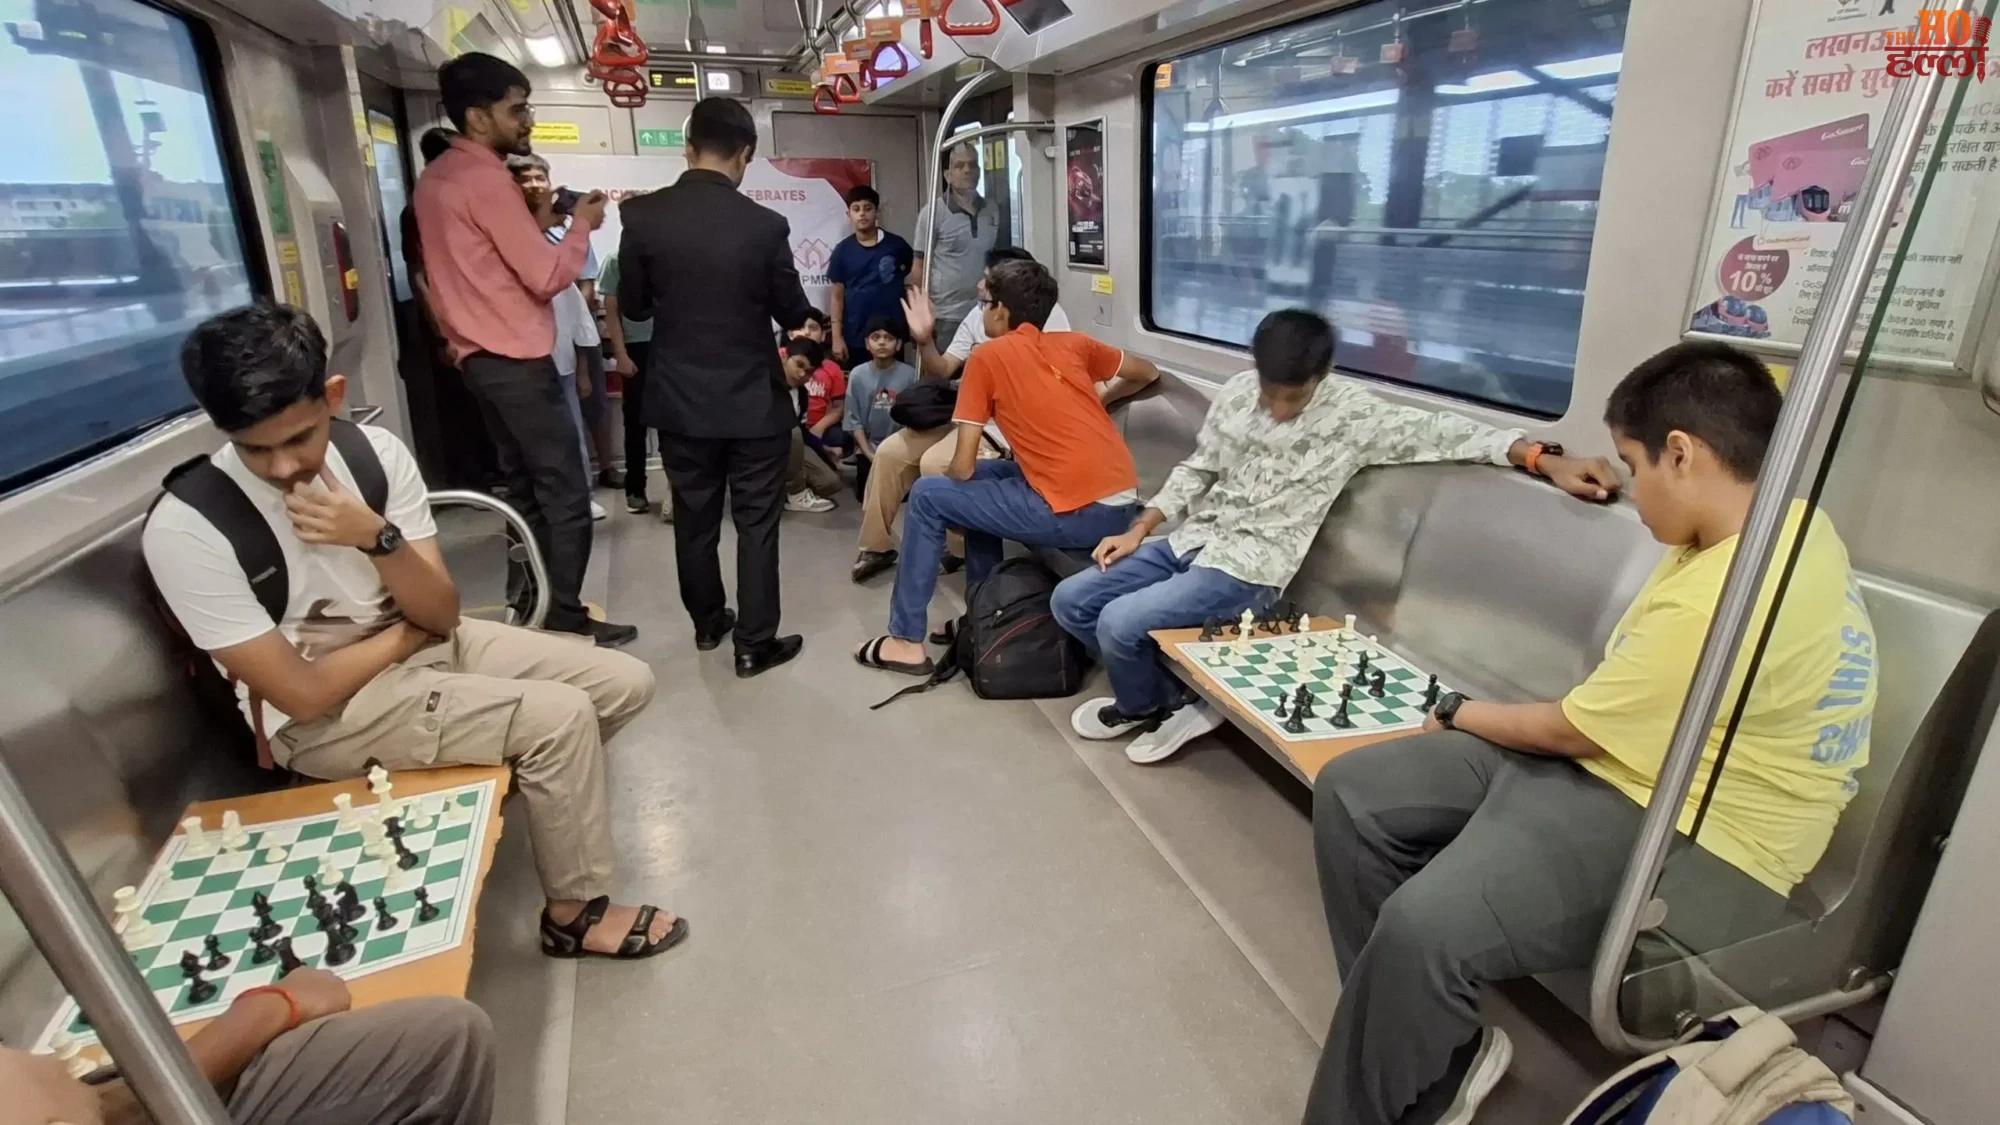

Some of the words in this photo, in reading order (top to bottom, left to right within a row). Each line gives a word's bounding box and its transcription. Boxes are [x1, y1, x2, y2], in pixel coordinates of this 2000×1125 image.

[1802, 63, 1856, 96] सबसे
[1952, 155, 1986, 172] सकती
[746, 189, 806, 201] EBRATES
[802, 274, 830, 285] PMR
[1908, 317, 1926, 327] 200
